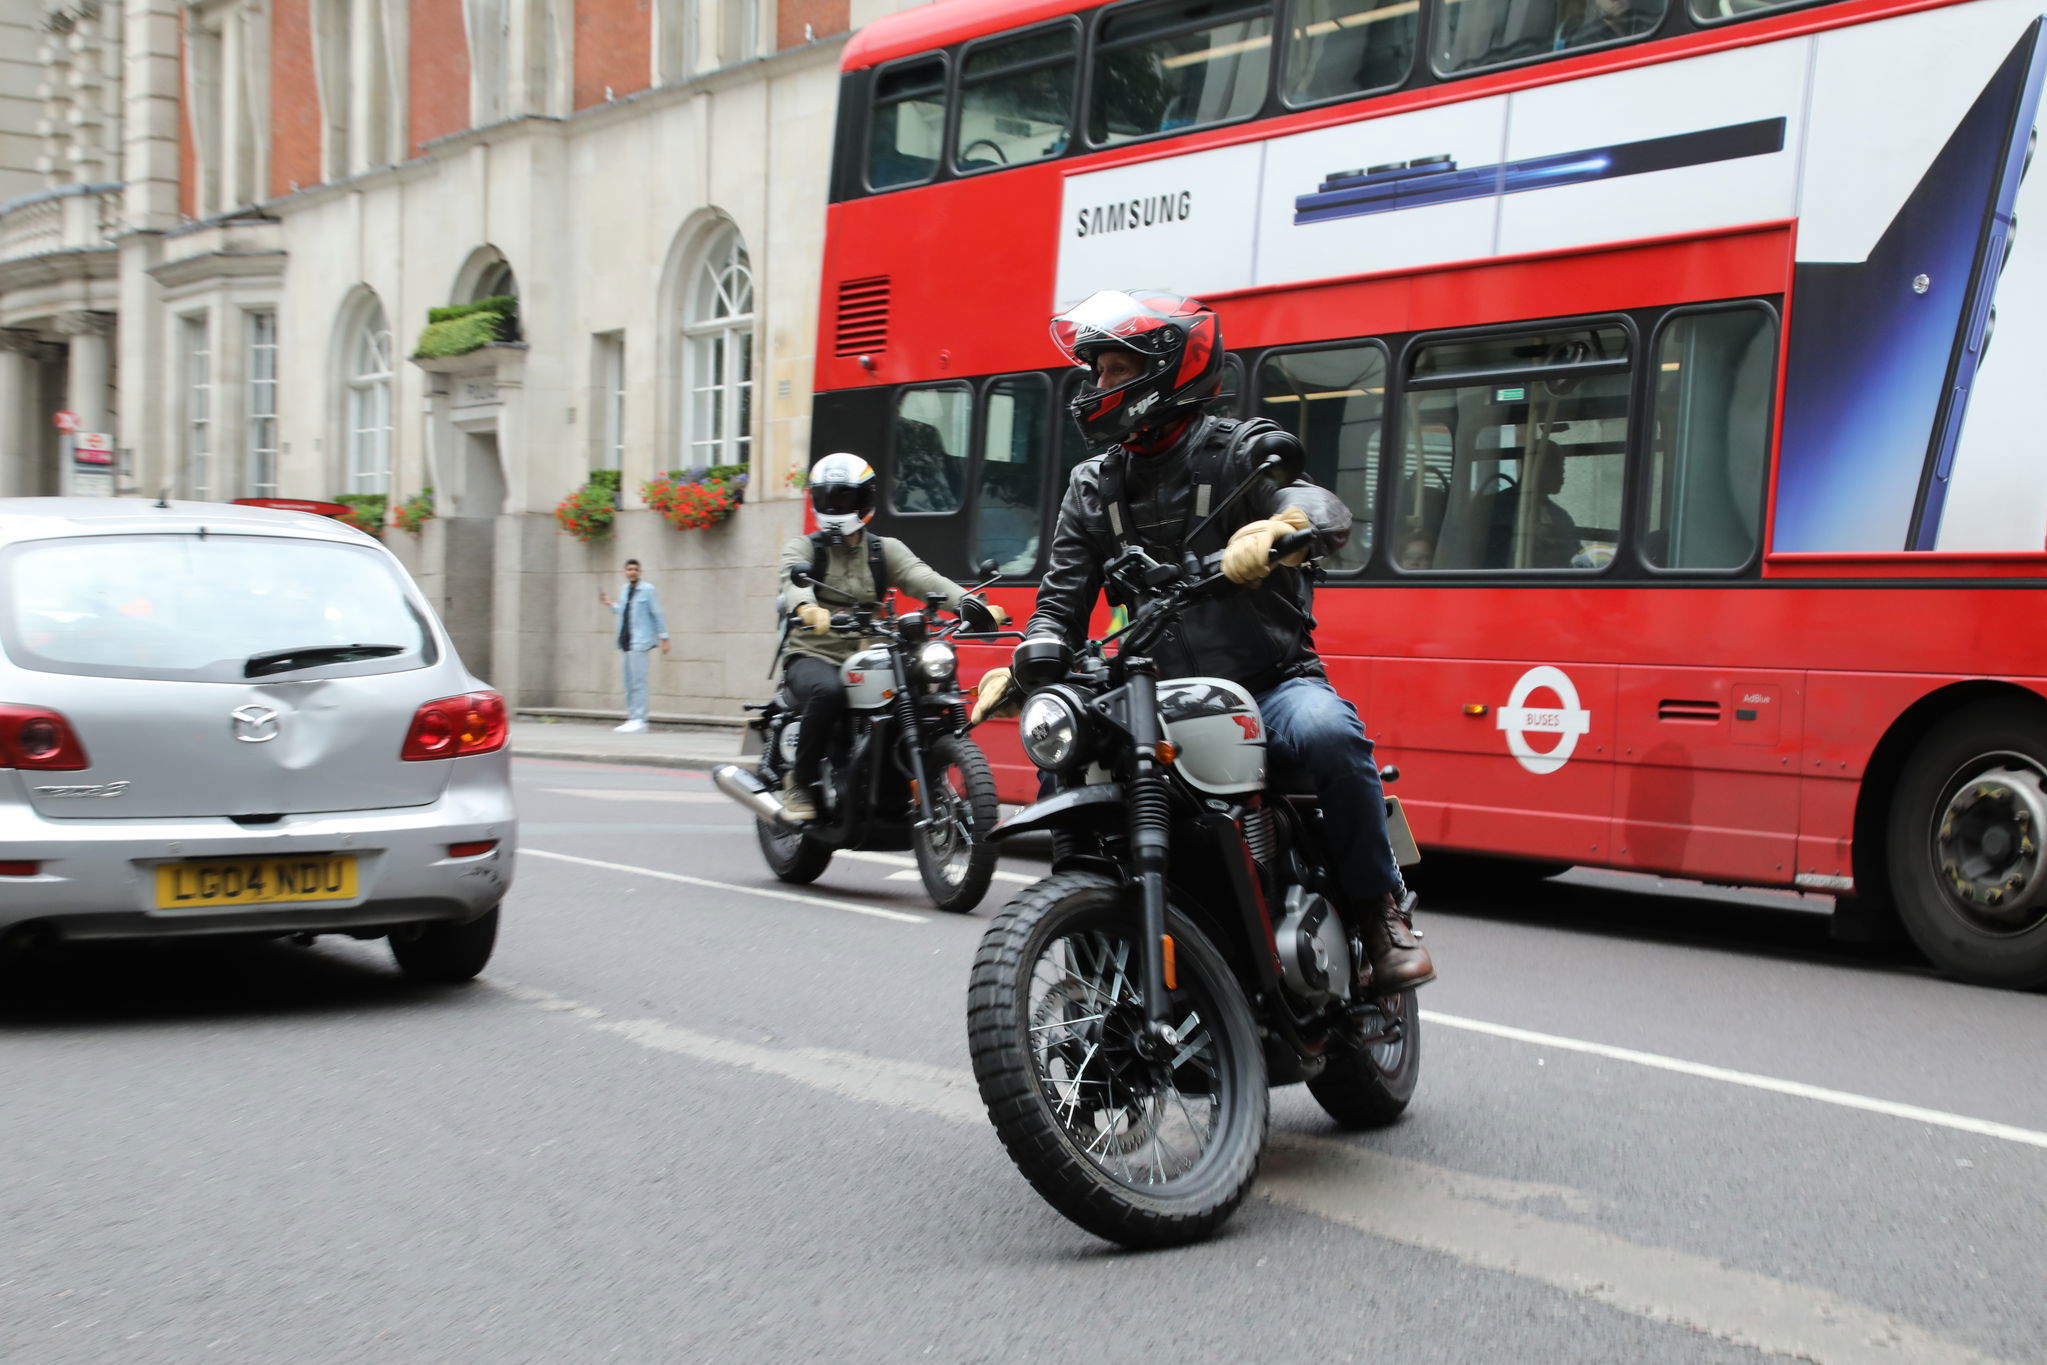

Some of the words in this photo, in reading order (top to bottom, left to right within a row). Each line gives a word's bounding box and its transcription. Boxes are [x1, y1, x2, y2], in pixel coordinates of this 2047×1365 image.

[1077, 190, 1190, 237] SAMSUNG
[1128, 391, 1160, 417] HJC
[1743, 693, 1771, 704] AdBlue
[1526, 713, 1561, 727] BUSES
[174, 855, 265, 901] LG04
[275, 851, 343, 895] NDU
